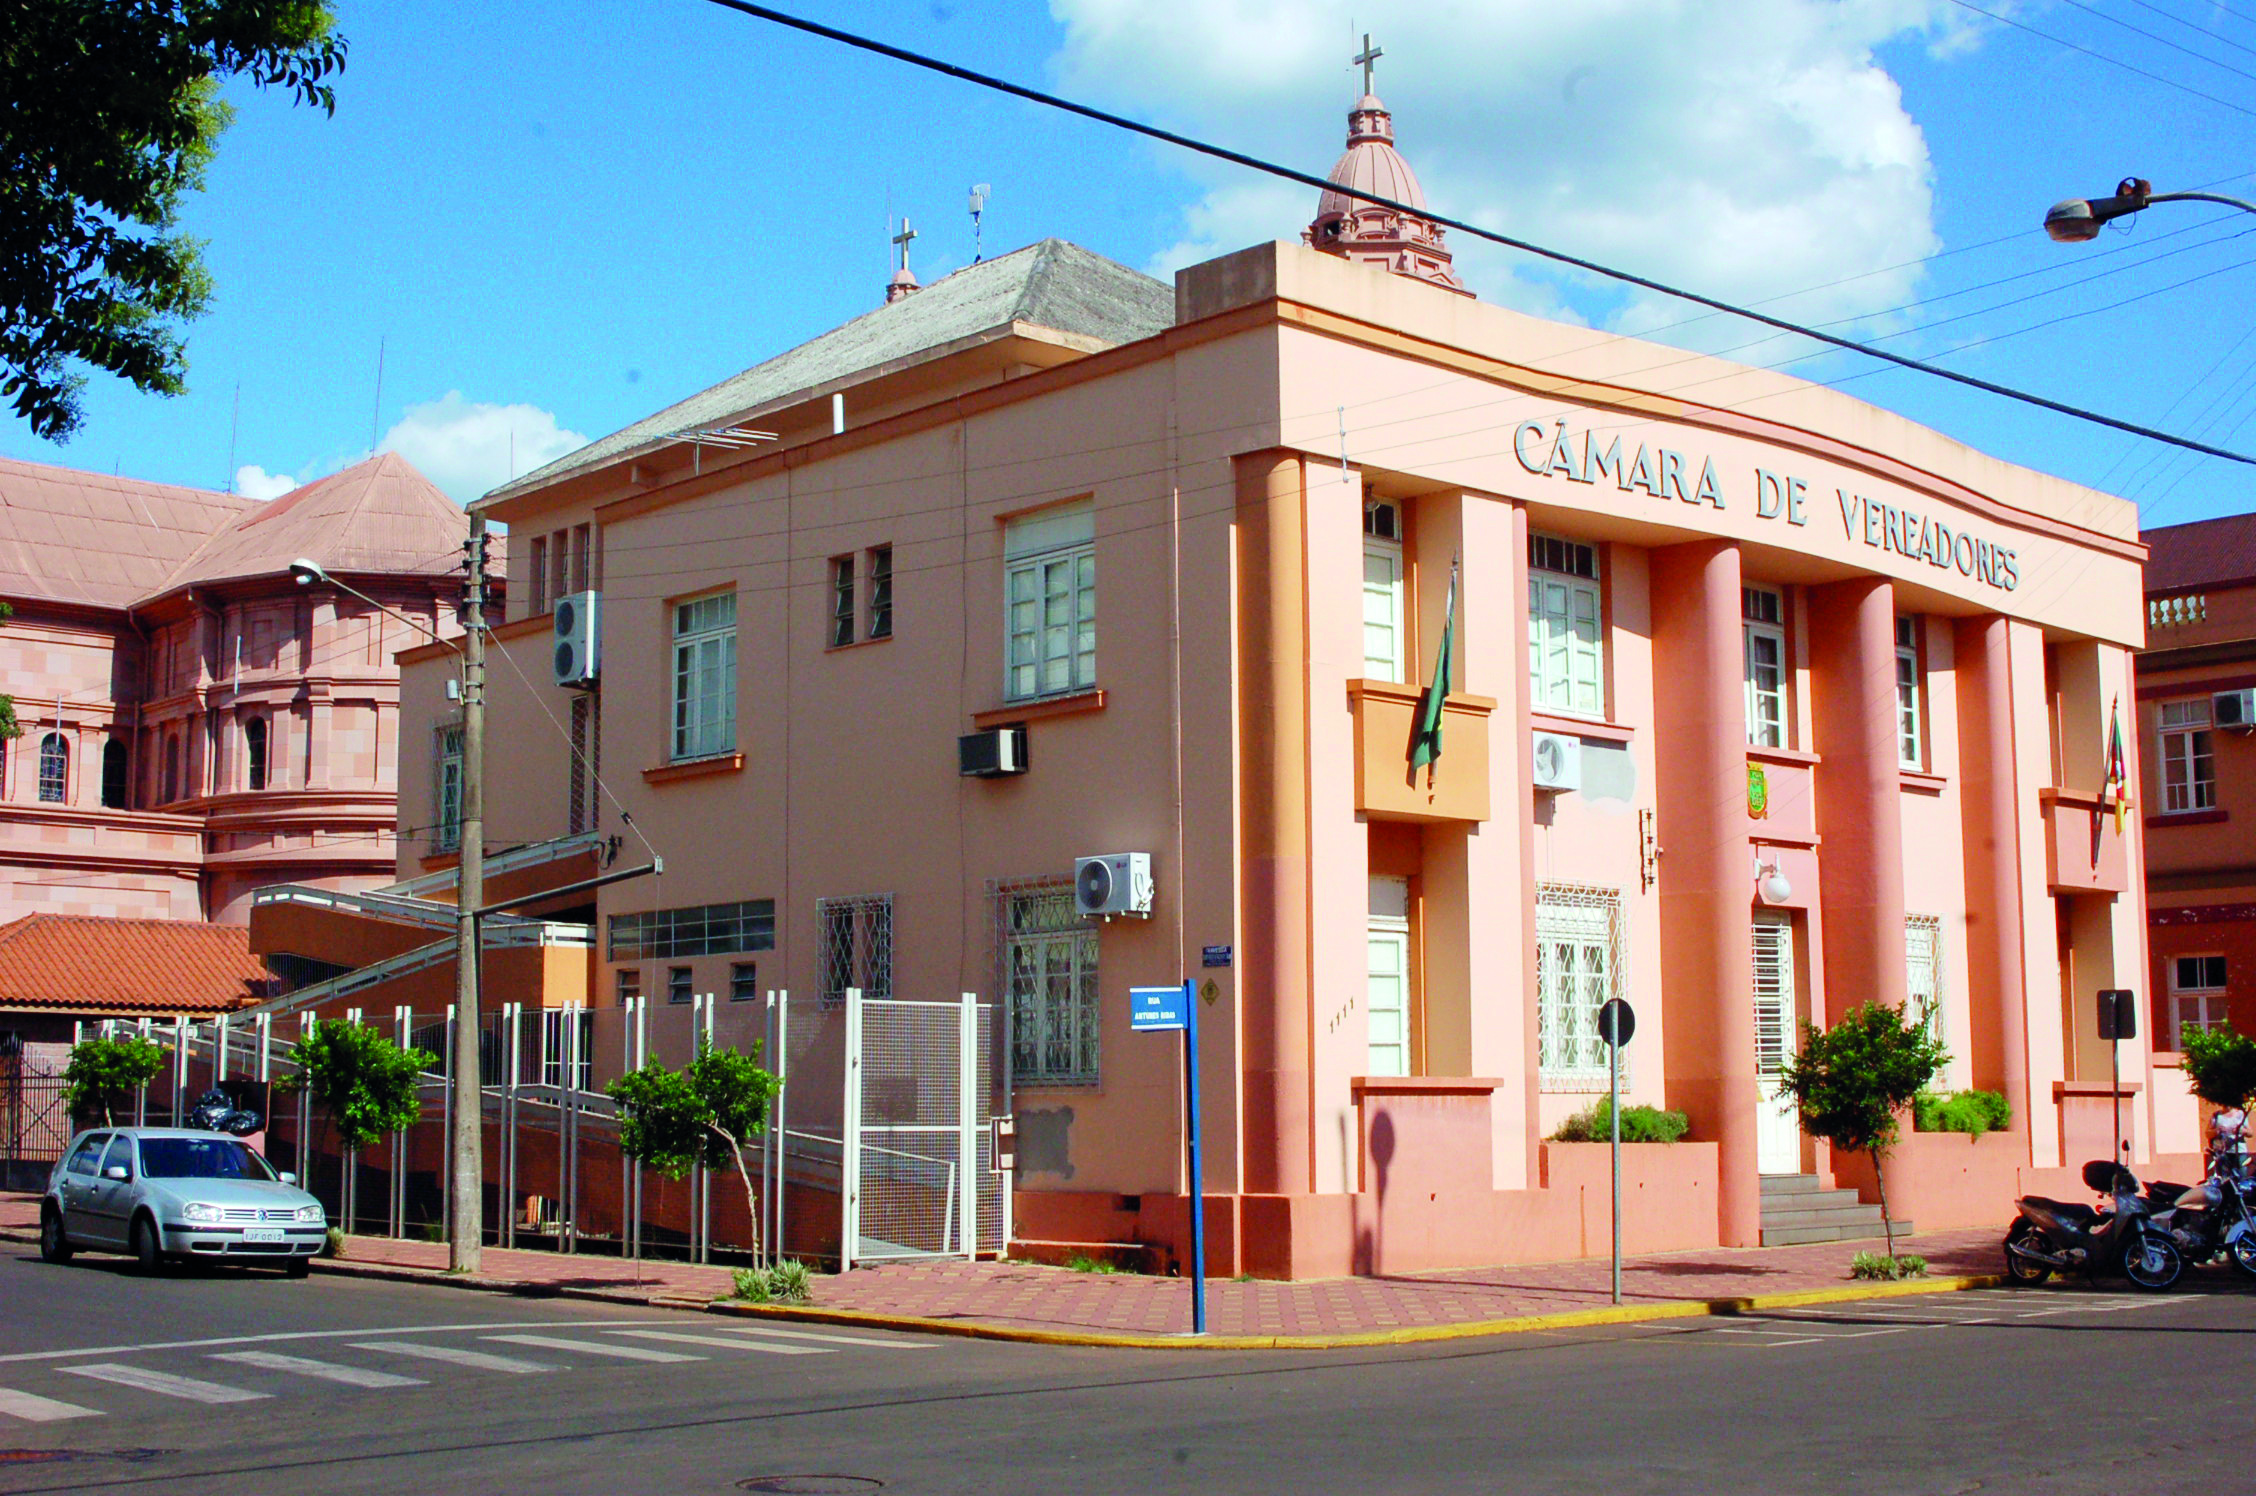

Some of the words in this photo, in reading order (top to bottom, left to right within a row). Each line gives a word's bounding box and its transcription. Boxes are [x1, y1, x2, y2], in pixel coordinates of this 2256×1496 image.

[1513, 417, 1725, 510] CÂMARA
[1755, 468, 1808, 527] DE
[1836, 488, 2020, 592] VEREADORES
[1147, 996, 1160, 1005] RUA
[1330, 995, 1354, 1034] 1111
